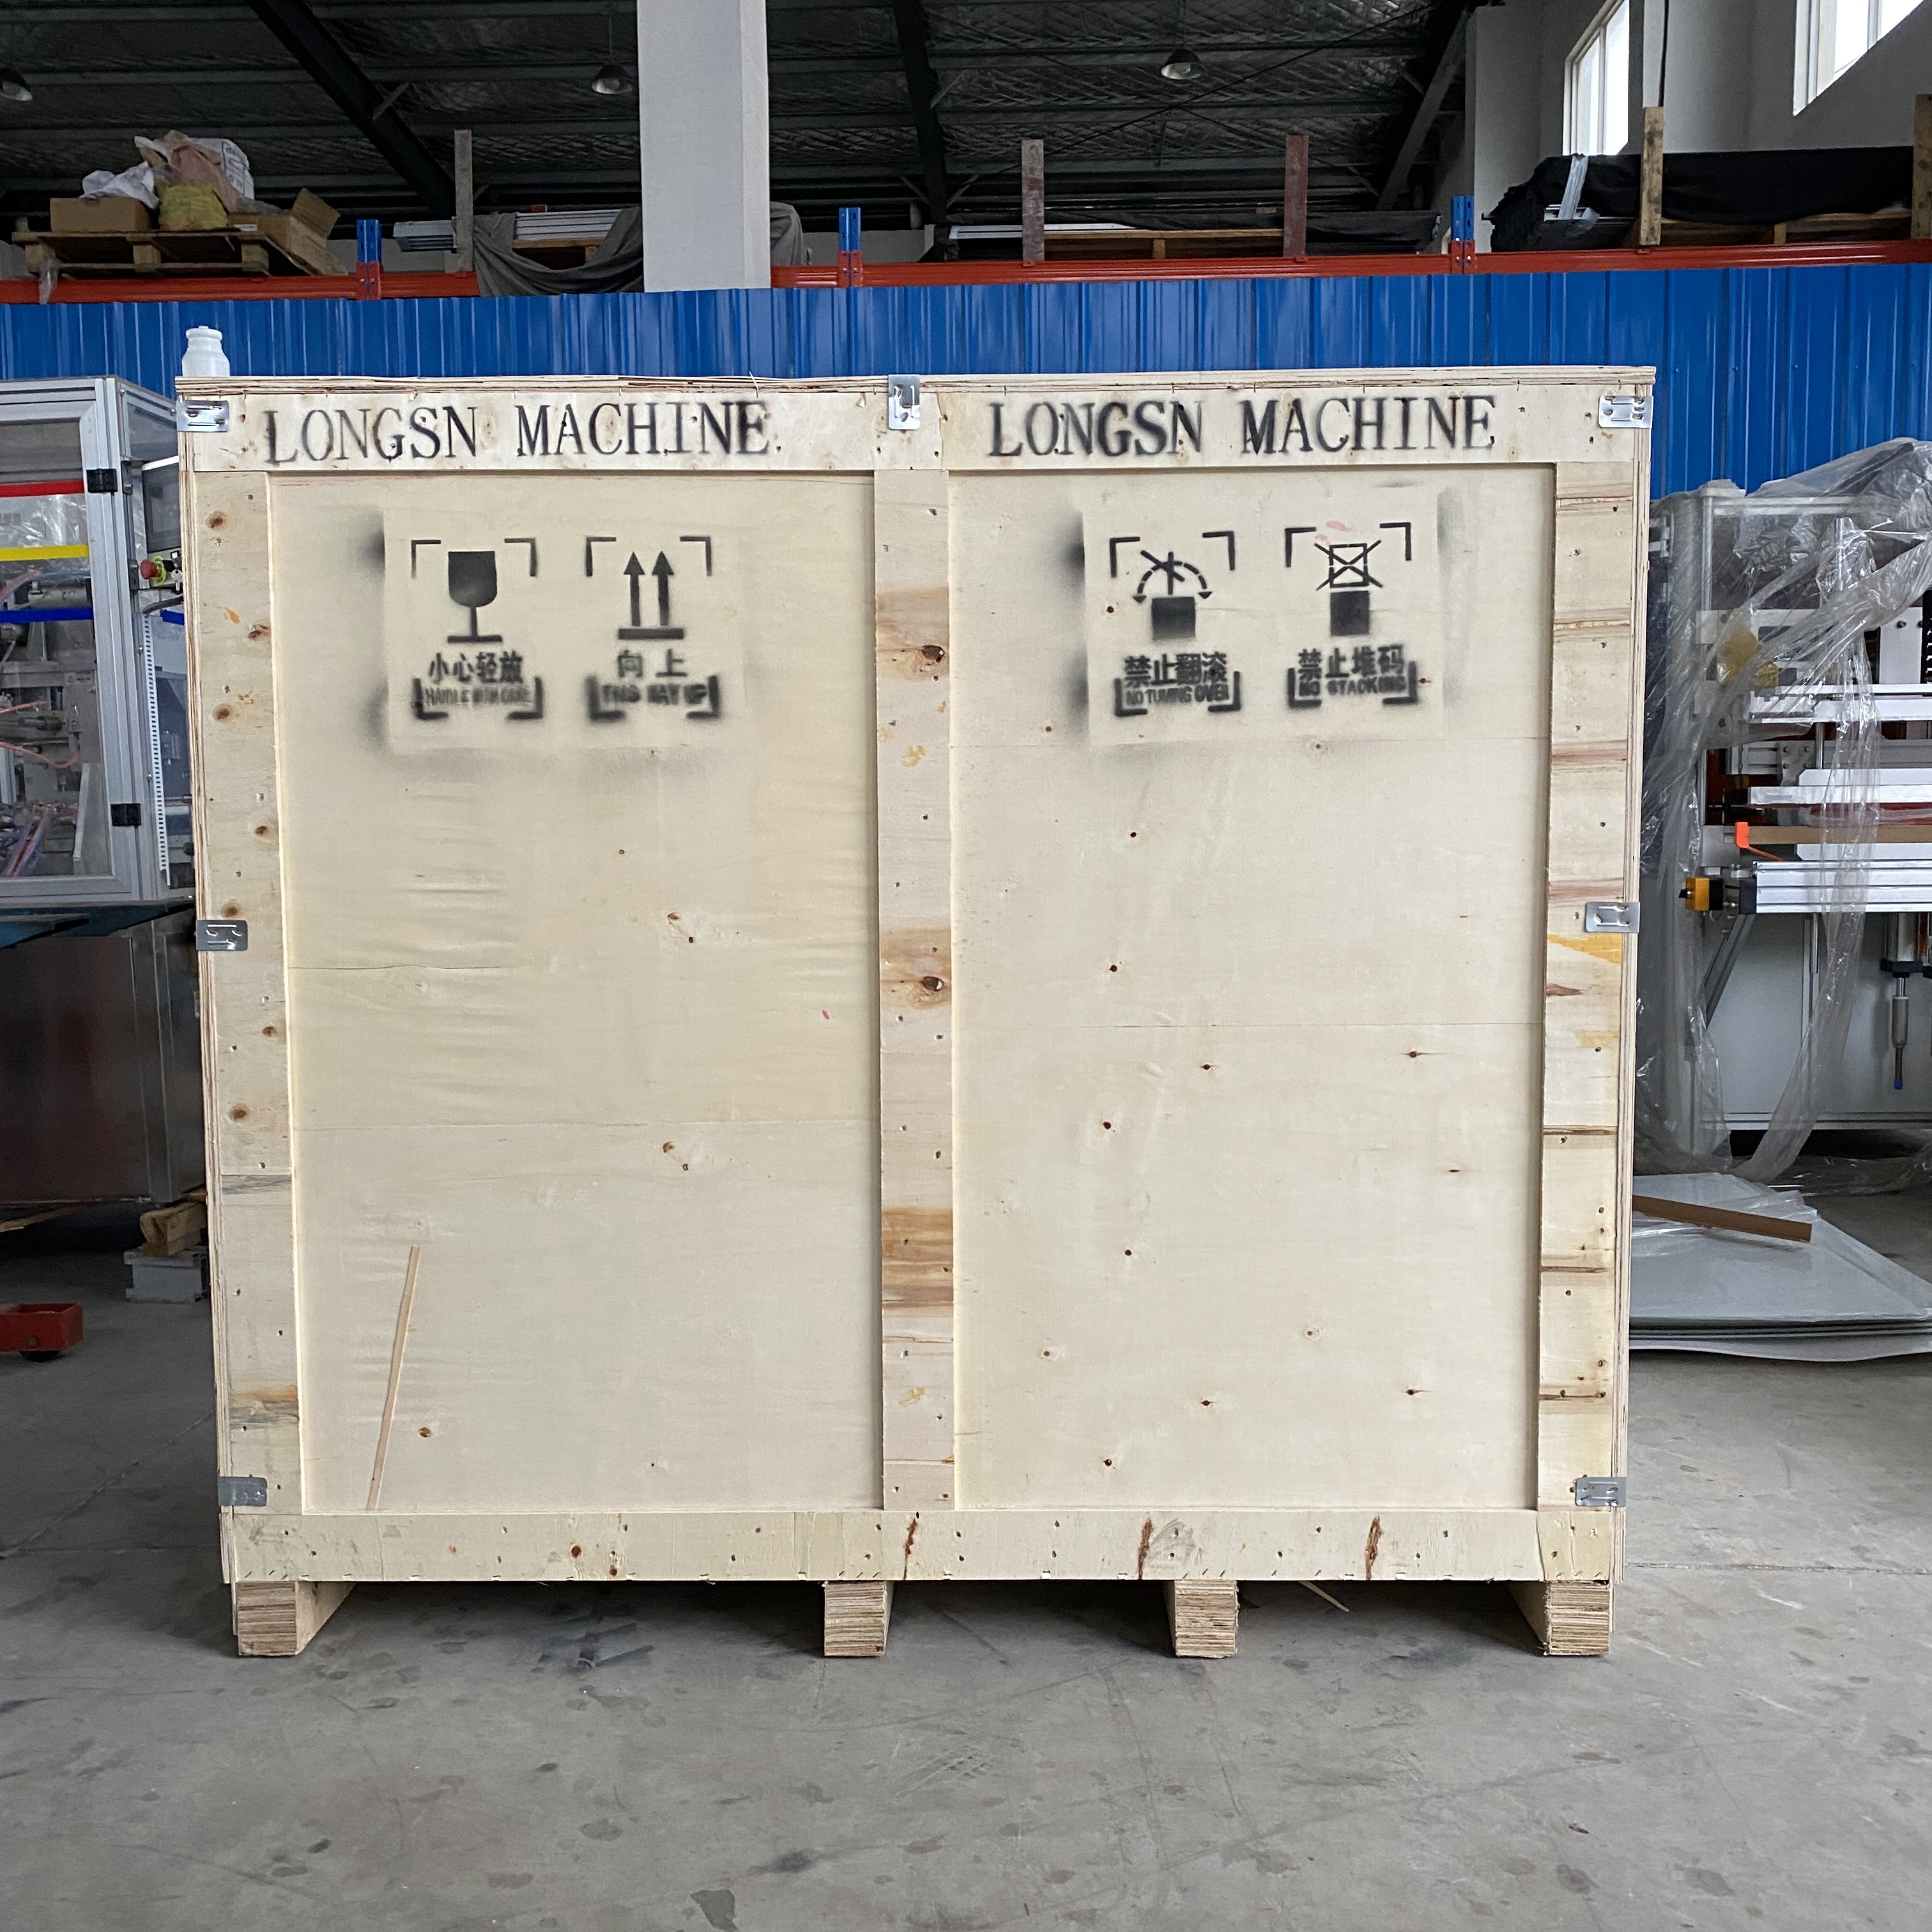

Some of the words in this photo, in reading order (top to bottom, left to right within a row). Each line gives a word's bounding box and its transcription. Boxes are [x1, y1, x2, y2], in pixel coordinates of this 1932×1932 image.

[263, 404, 478, 464] LONGSN
[516, 400, 769, 457] MACHINE
[988, 400, 1202, 457] LONGSN
[1241, 395, 1497, 455] MACHINE
[428, 650, 523, 684] 小心轻放
[617, 648, 688, 678] 向上
[1124, 651, 1227, 689] 禁止翻滚
[1297, 643, 1404, 682] 禁止堆码
[1126, 689, 1144, 705] NO
